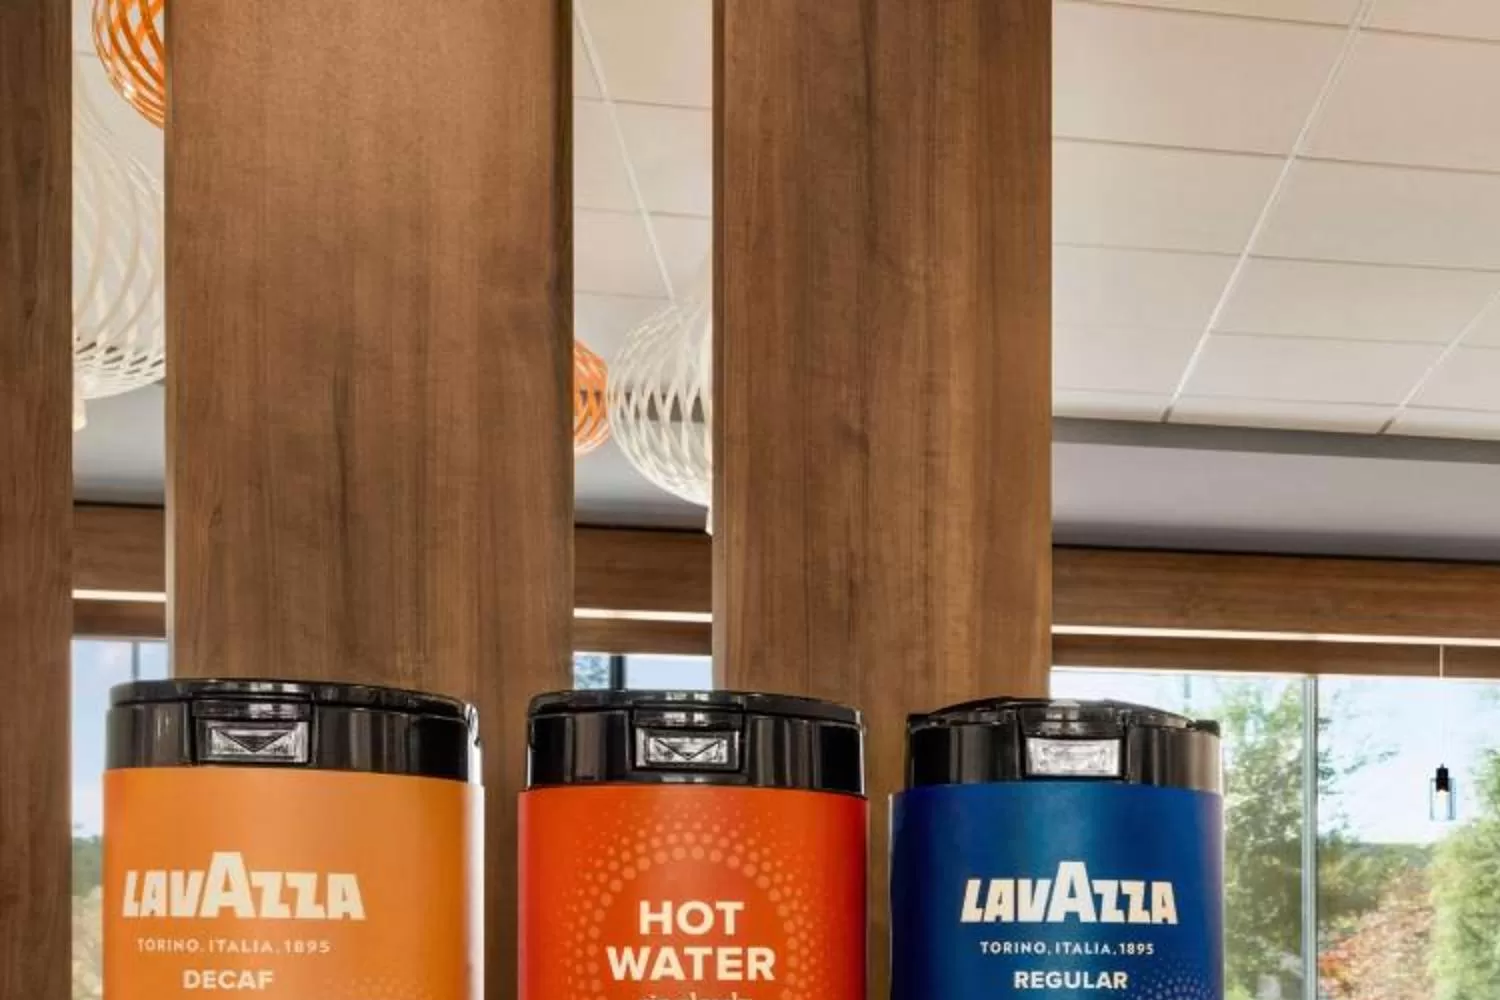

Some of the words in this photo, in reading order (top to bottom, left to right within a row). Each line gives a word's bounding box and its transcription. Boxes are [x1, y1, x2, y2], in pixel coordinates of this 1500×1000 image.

[123, 852, 366, 920] LAVAZZA
[960, 861, 1178, 924] LAVAZZA
[639, 901, 745, 935] HOT
[284, 941, 331, 954] 1895
[1119, 943, 1154, 955] 1895
[606, 946, 777, 981] WATER
[182, 969, 274, 990] DECAF
[1013, 971, 1129, 989] REGULAR
